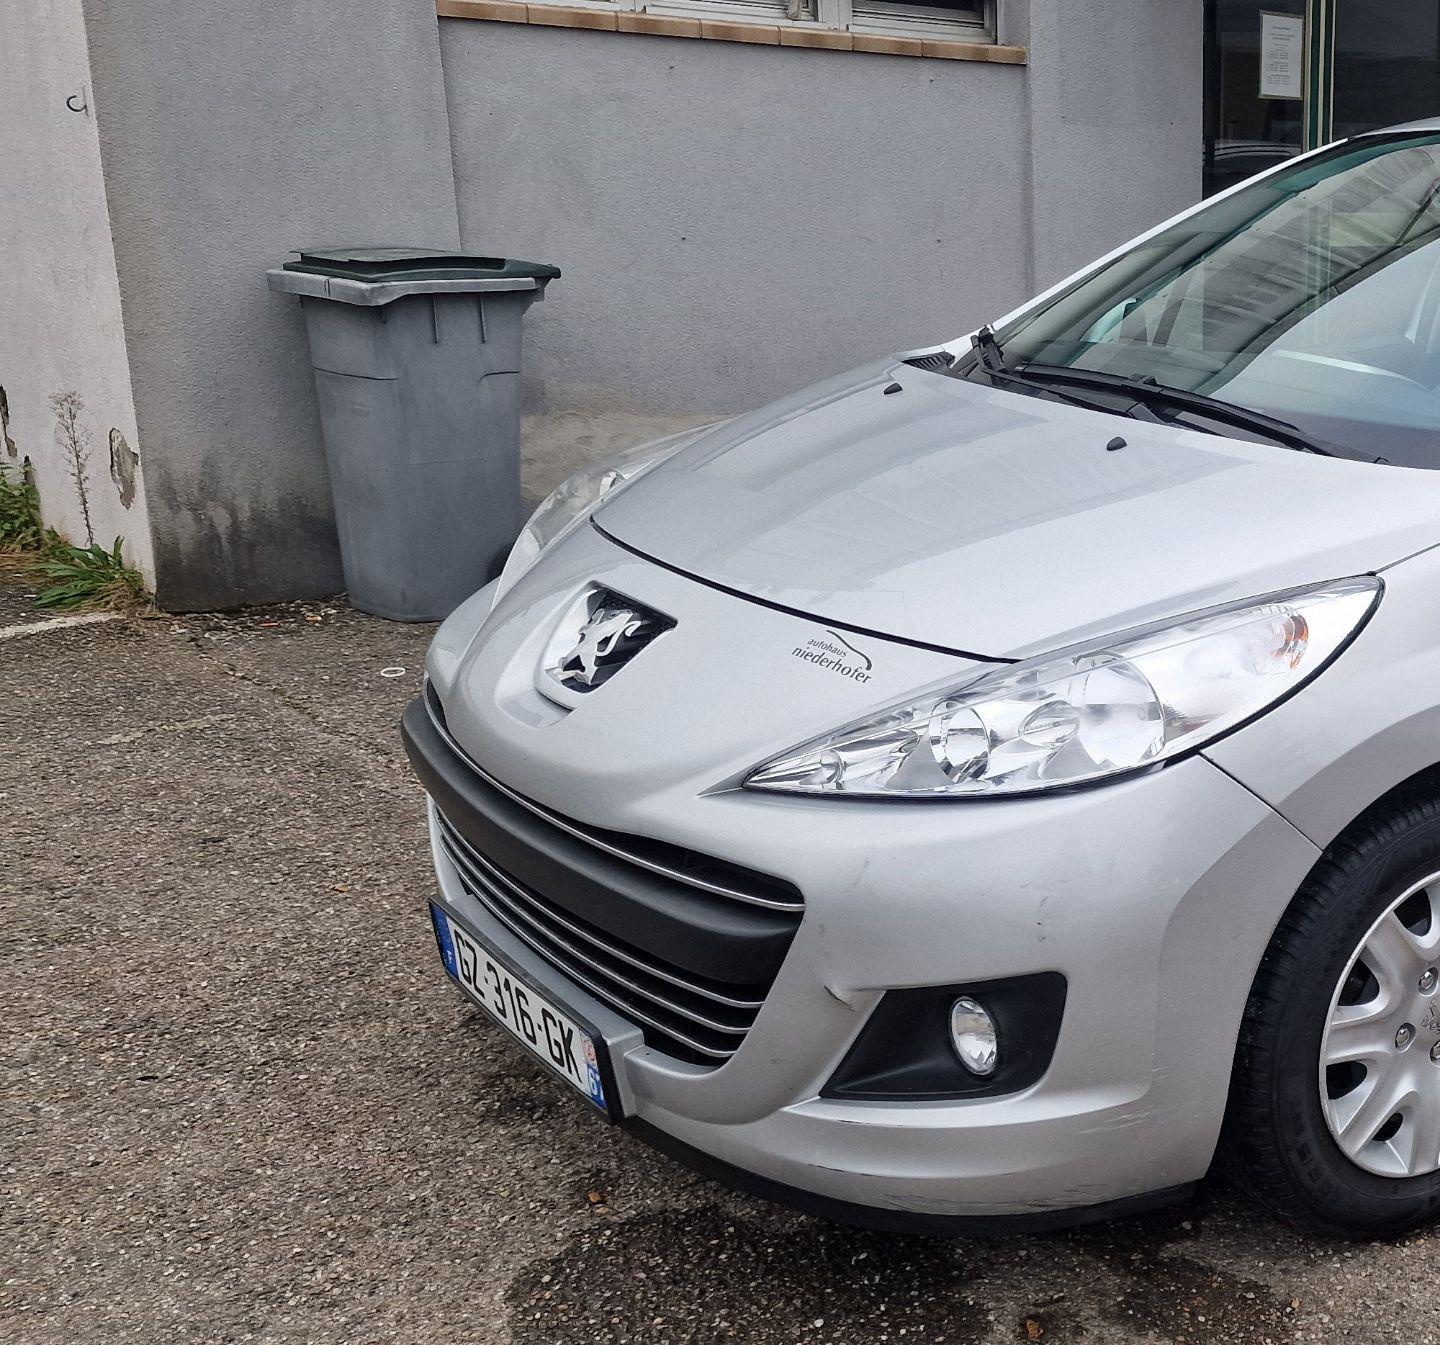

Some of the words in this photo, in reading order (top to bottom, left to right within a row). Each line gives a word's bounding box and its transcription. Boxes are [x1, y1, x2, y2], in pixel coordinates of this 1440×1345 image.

[791, 646, 872, 684] niederhofer
[807, 639, 848, 658] autohaus
[453, 928, 583, 1085] GZ-316-GK
